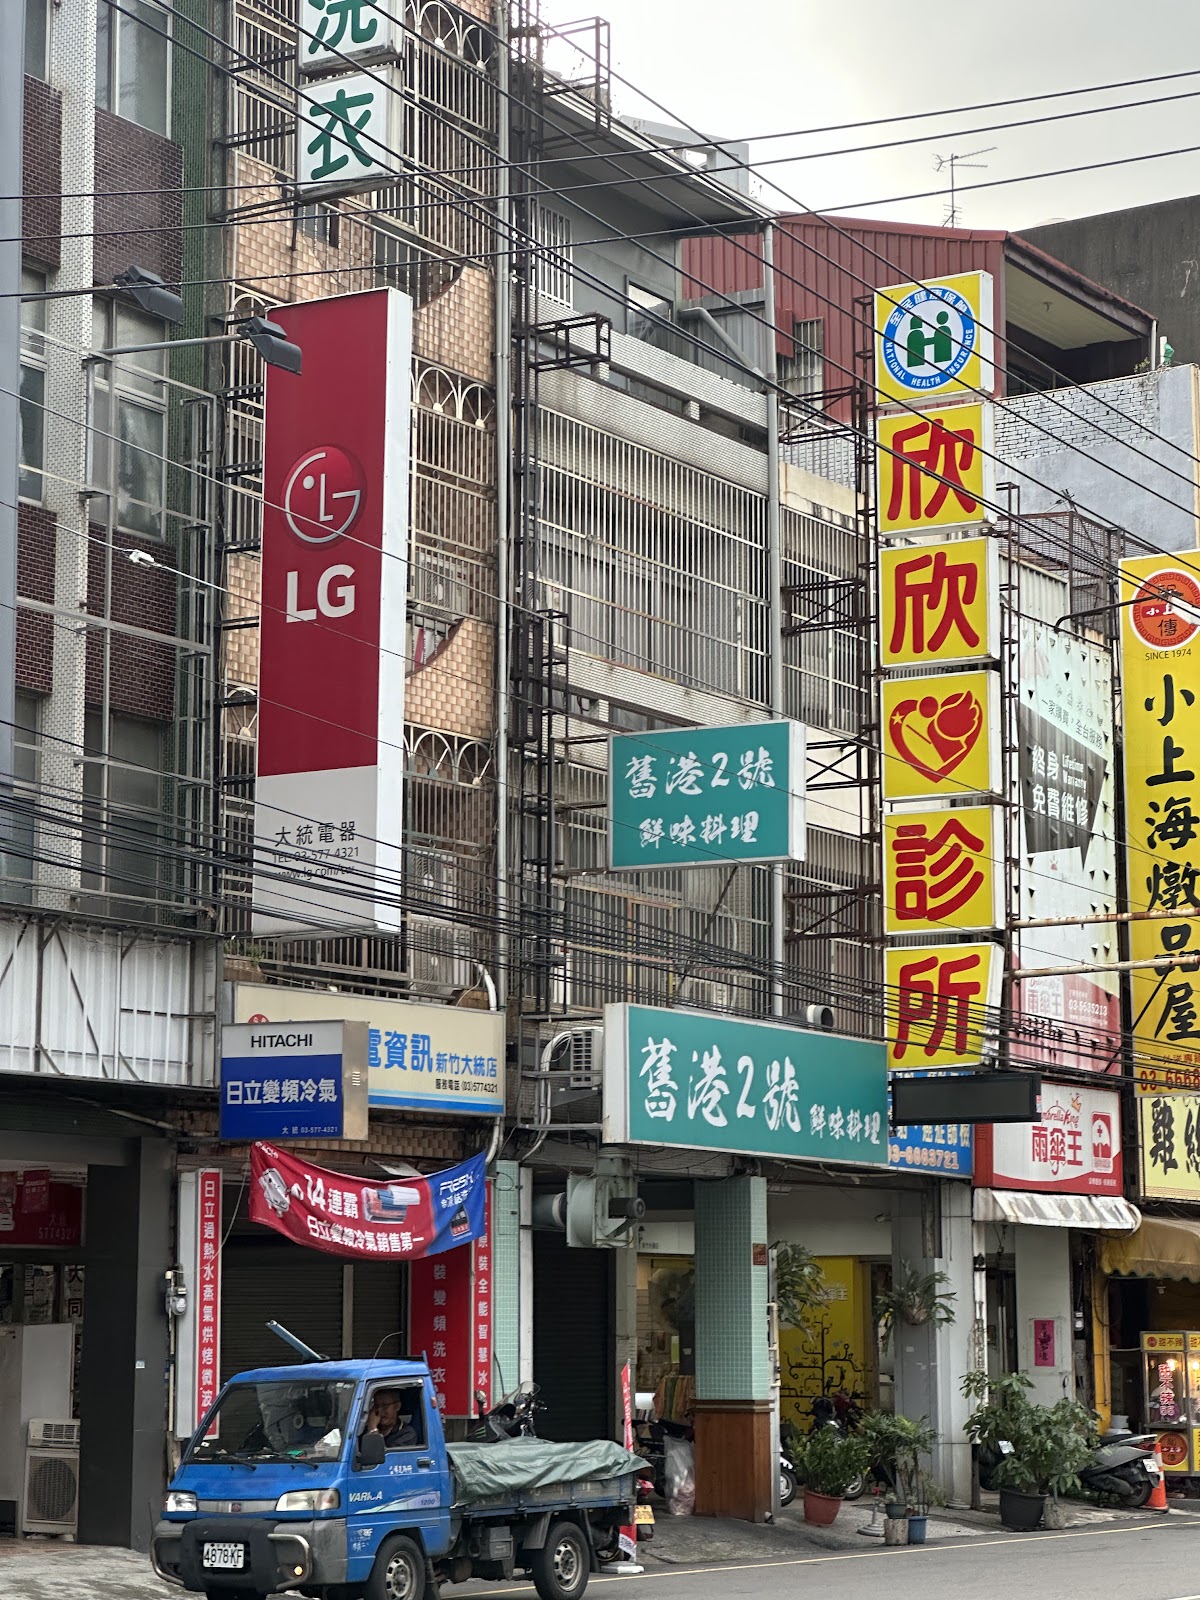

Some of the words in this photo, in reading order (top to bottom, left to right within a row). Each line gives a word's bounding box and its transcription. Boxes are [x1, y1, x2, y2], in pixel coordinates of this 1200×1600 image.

[889, 288, 968, 326] 全民健康保險
[885, 342, 905, 381] NATIONAL
[911, 376, 941, 387] HEALTH
[946, 328, 974, 377] INSURANCE
[286, 564, 355, 623] LG
[1145, 651, 1169, 661] SINCE
[1172, 648, 1192, 658] 1974
[624, 746, 776, 799] 舊港2號
[1031, 744, 1060, 781] 終身
[1032, 783, 1089, 827] 免費維修
[274, 821, 356, 847] 大統電器
[639, 811, 760, 849] 鮮味料理
[250, 1033, 313, 1048] HITACHI
[436, 1052, 497, 1077] 新竹大統店
[226, 1078, 337, 1105] 日立變頻冷氣
[435, 1079, 460, 1091] 服務電話
[639, 1037, 802, 1133] 舊港2號
[301, 1126, 338, 1134] 03-577-4321
[809, 1104, 881, 1145] 鮮味料理
[1042, 1111, 1064, 1121] mbrella
[1032, 1126, 1083, 1169] 雨傘王
[306, 1215, 425, 1253] 日立變頻冷氣銷售第一
[433, 1252, 447, 1410] 裝變頻洗衣機
[420, 1498, 435, 1506] 1200
[203, 1548, 244, 1565] 4878-KF
